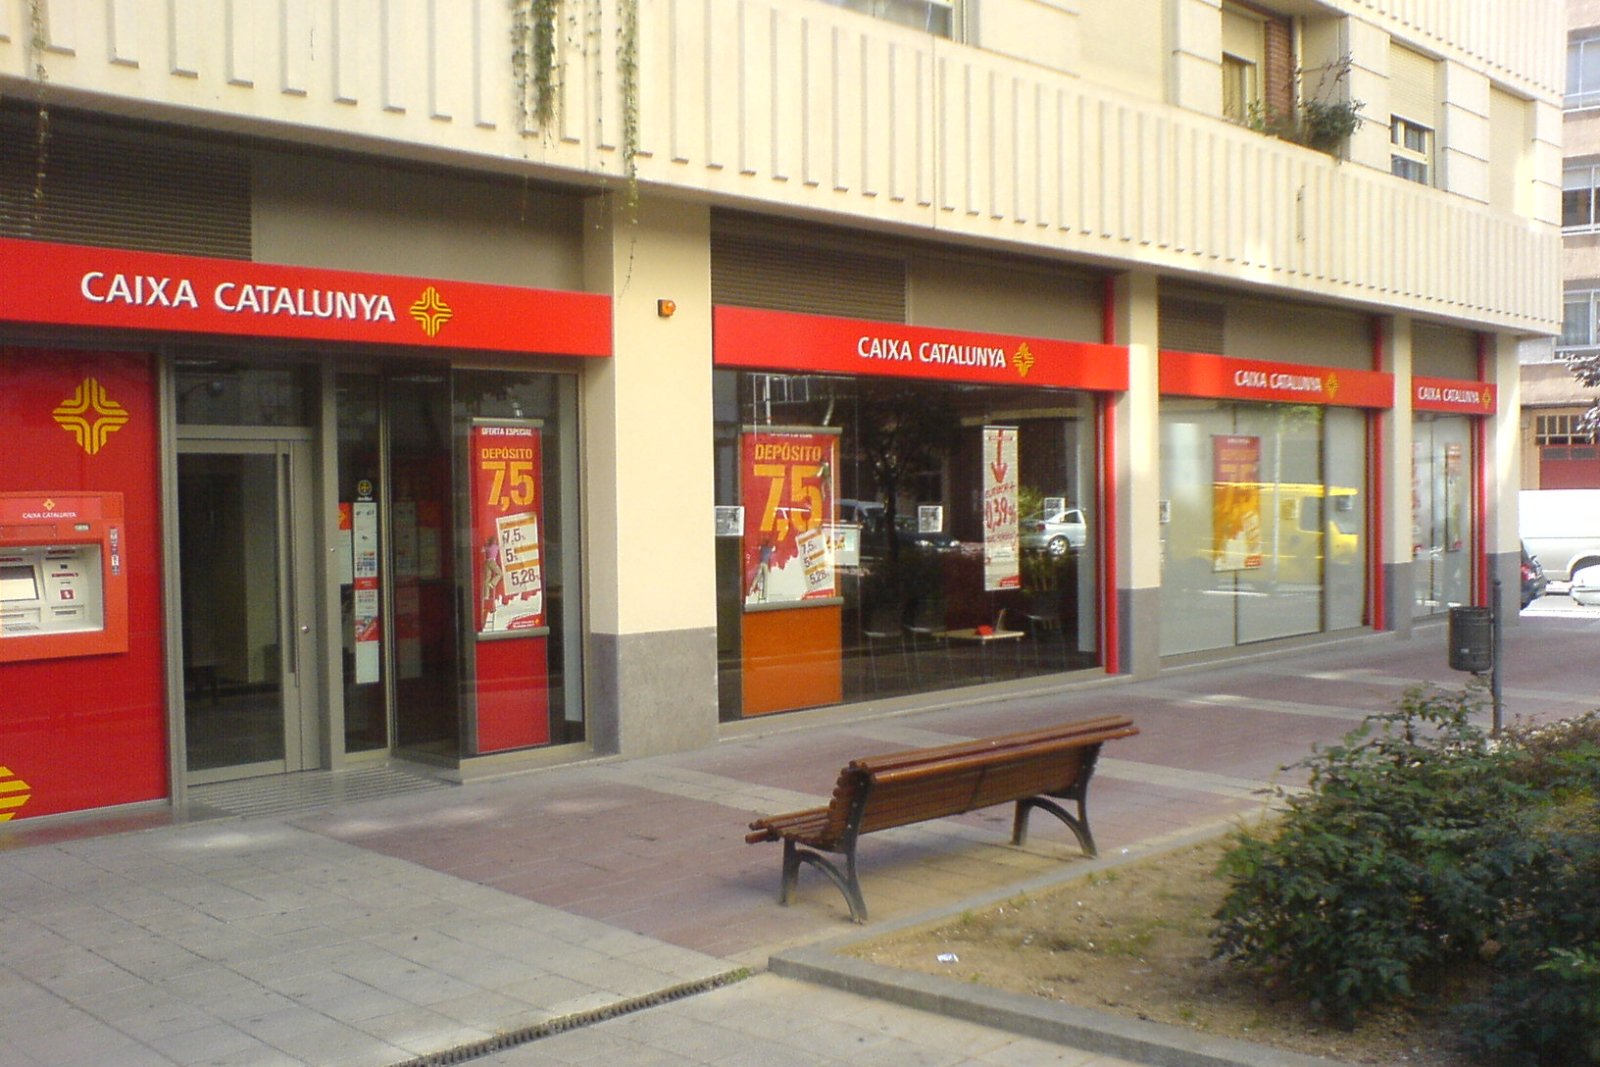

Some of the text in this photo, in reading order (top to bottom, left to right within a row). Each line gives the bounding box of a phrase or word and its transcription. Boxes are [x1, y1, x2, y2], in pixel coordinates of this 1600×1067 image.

[80, 271, 396, 322] CAIXA CATALUNYA
[857, 336, 1006, 368] CAIXA CATALUNYA
[1234, 370, 1322, 392] CAIXA CATALUNYA
[1418, 386, 1480, 404] CAIXA CATALUNYA
[481, 427, 532, 437] OFERTA ESPECIAL
[481, 446, 533, 459] DEPÓSITO
[754, 442, 822, 461] DEPÓSITO
[481, 461, 535, 512] 7,5
[753, 463, 823, 541] 7,5
[22, 511, 42, 519] CAIXA
